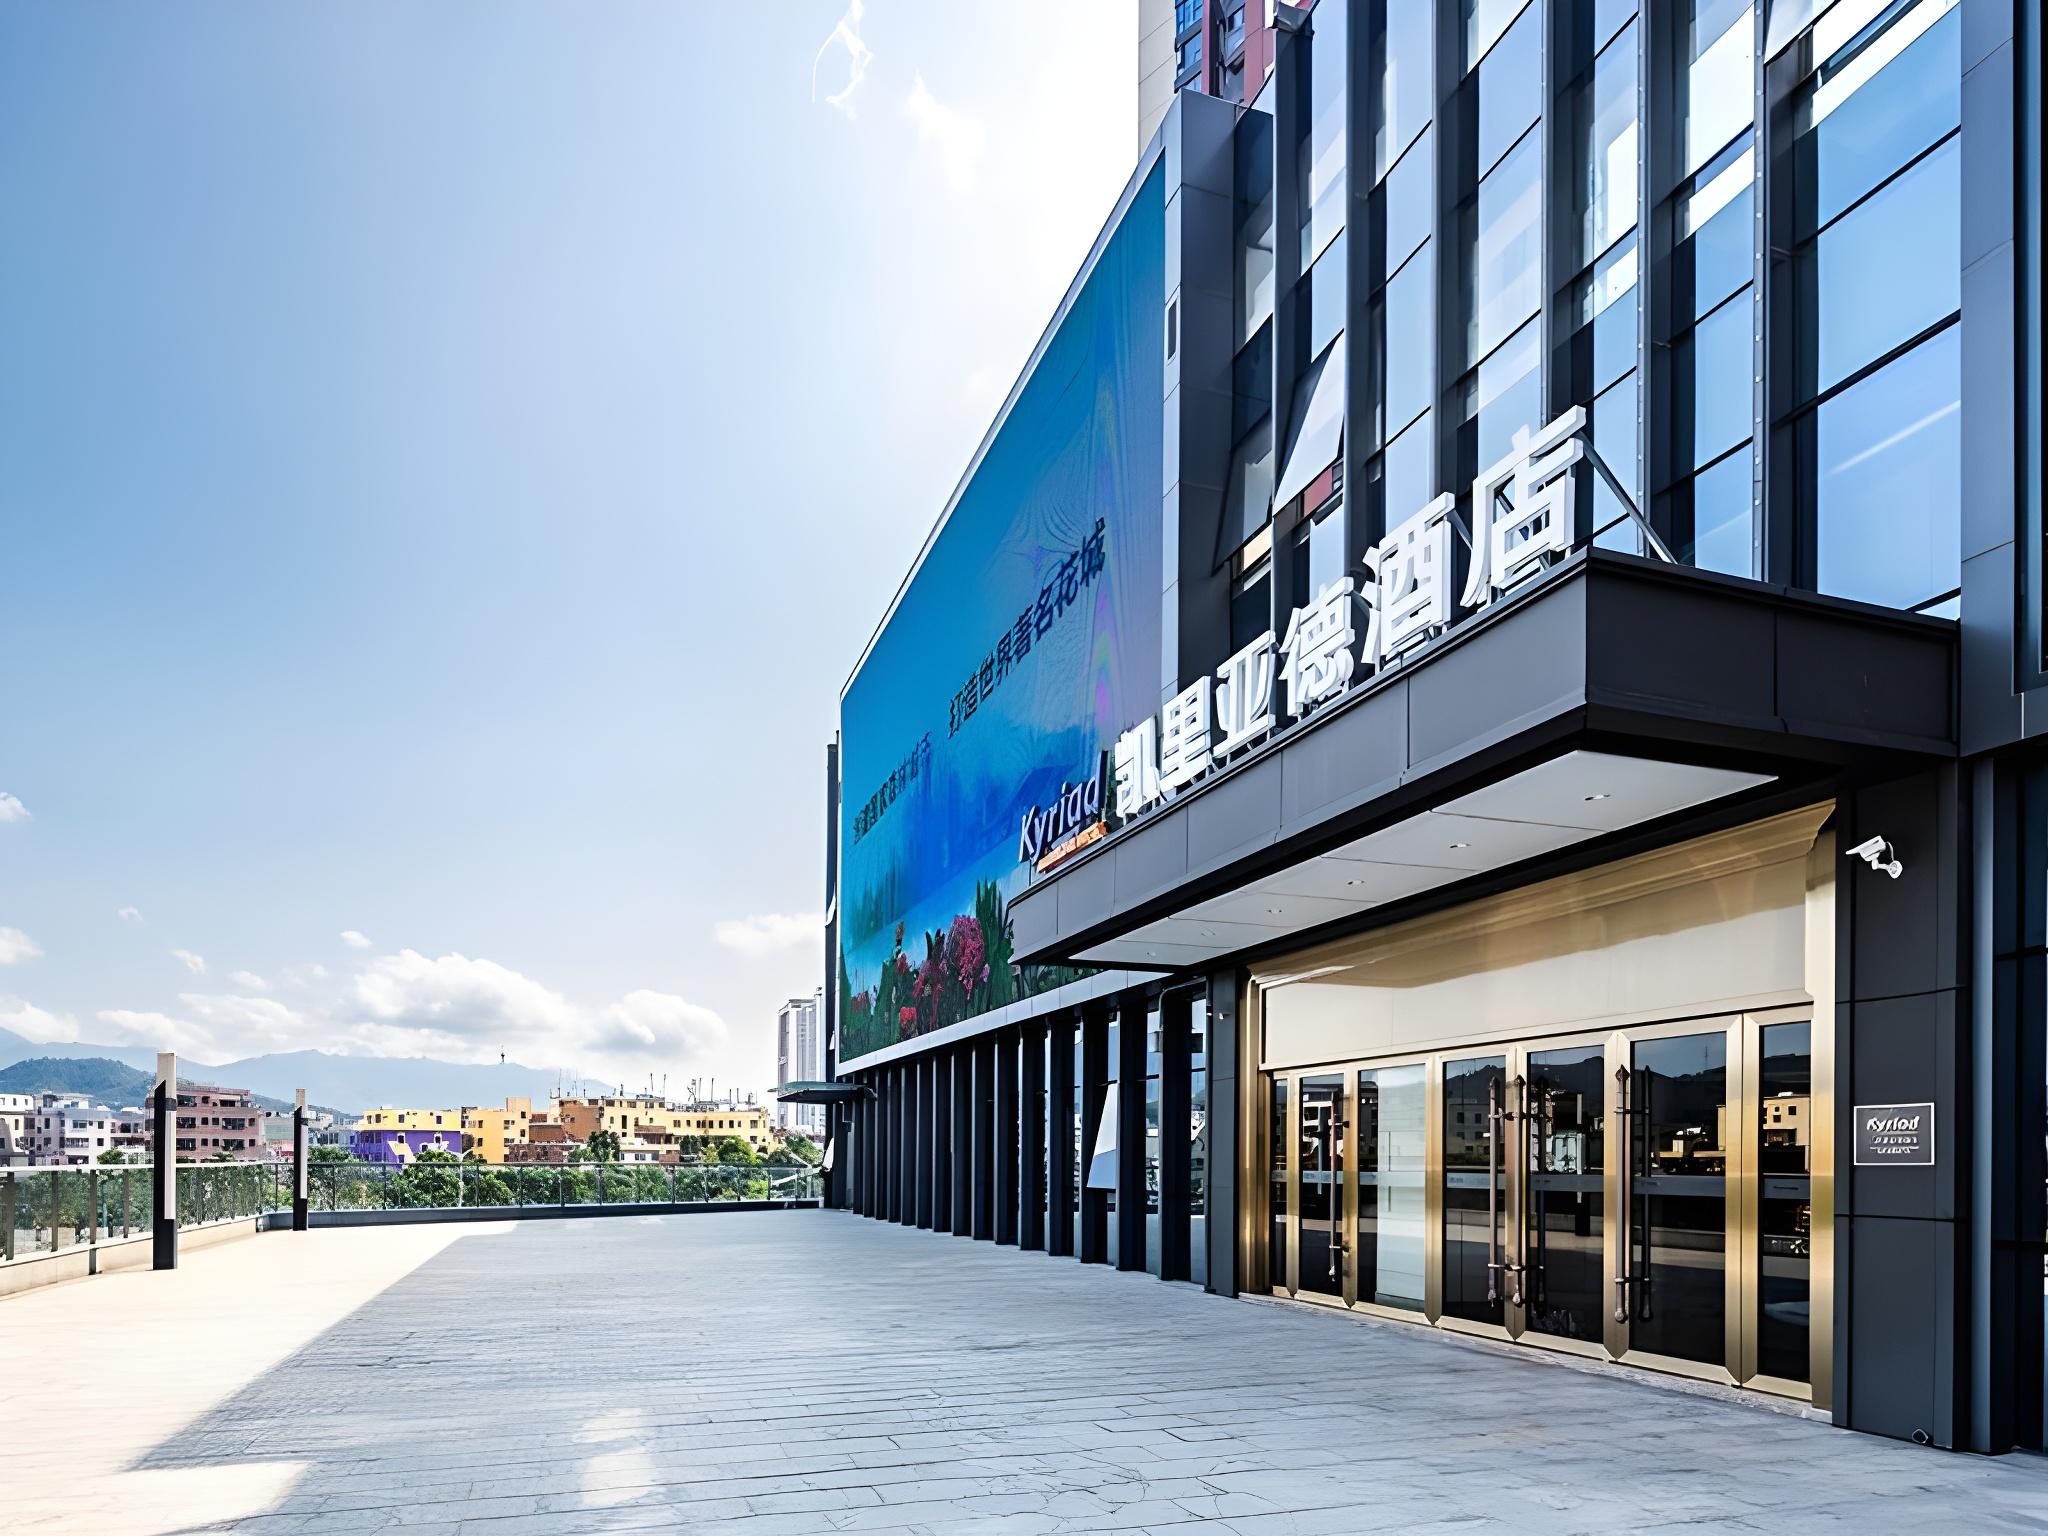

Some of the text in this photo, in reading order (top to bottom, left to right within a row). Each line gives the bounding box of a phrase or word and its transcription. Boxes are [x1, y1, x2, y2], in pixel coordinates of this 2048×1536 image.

[1114, 405, 1586, 819] 凯里亚德酒店
[1018, 751, 1106, 865] Kyriad
